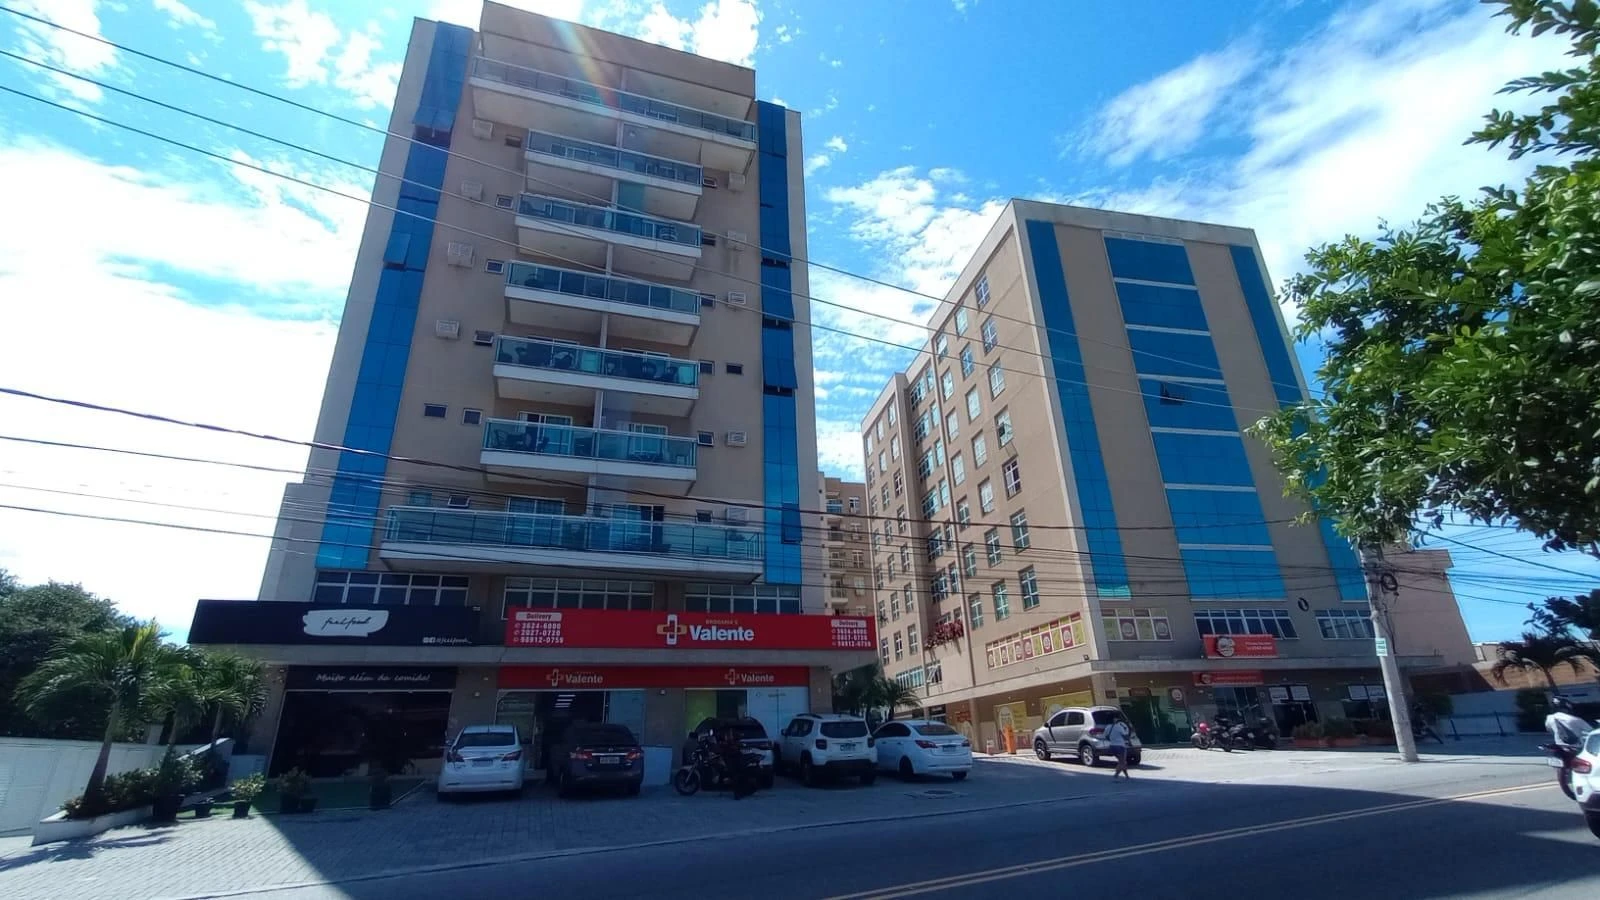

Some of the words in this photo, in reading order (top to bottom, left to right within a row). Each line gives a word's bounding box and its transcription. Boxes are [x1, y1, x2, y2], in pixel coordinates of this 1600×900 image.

[689, 624, 755, 642] Valente
[565, 673, 604, 684] Valente
[740, 672, 775, 683] Valente
